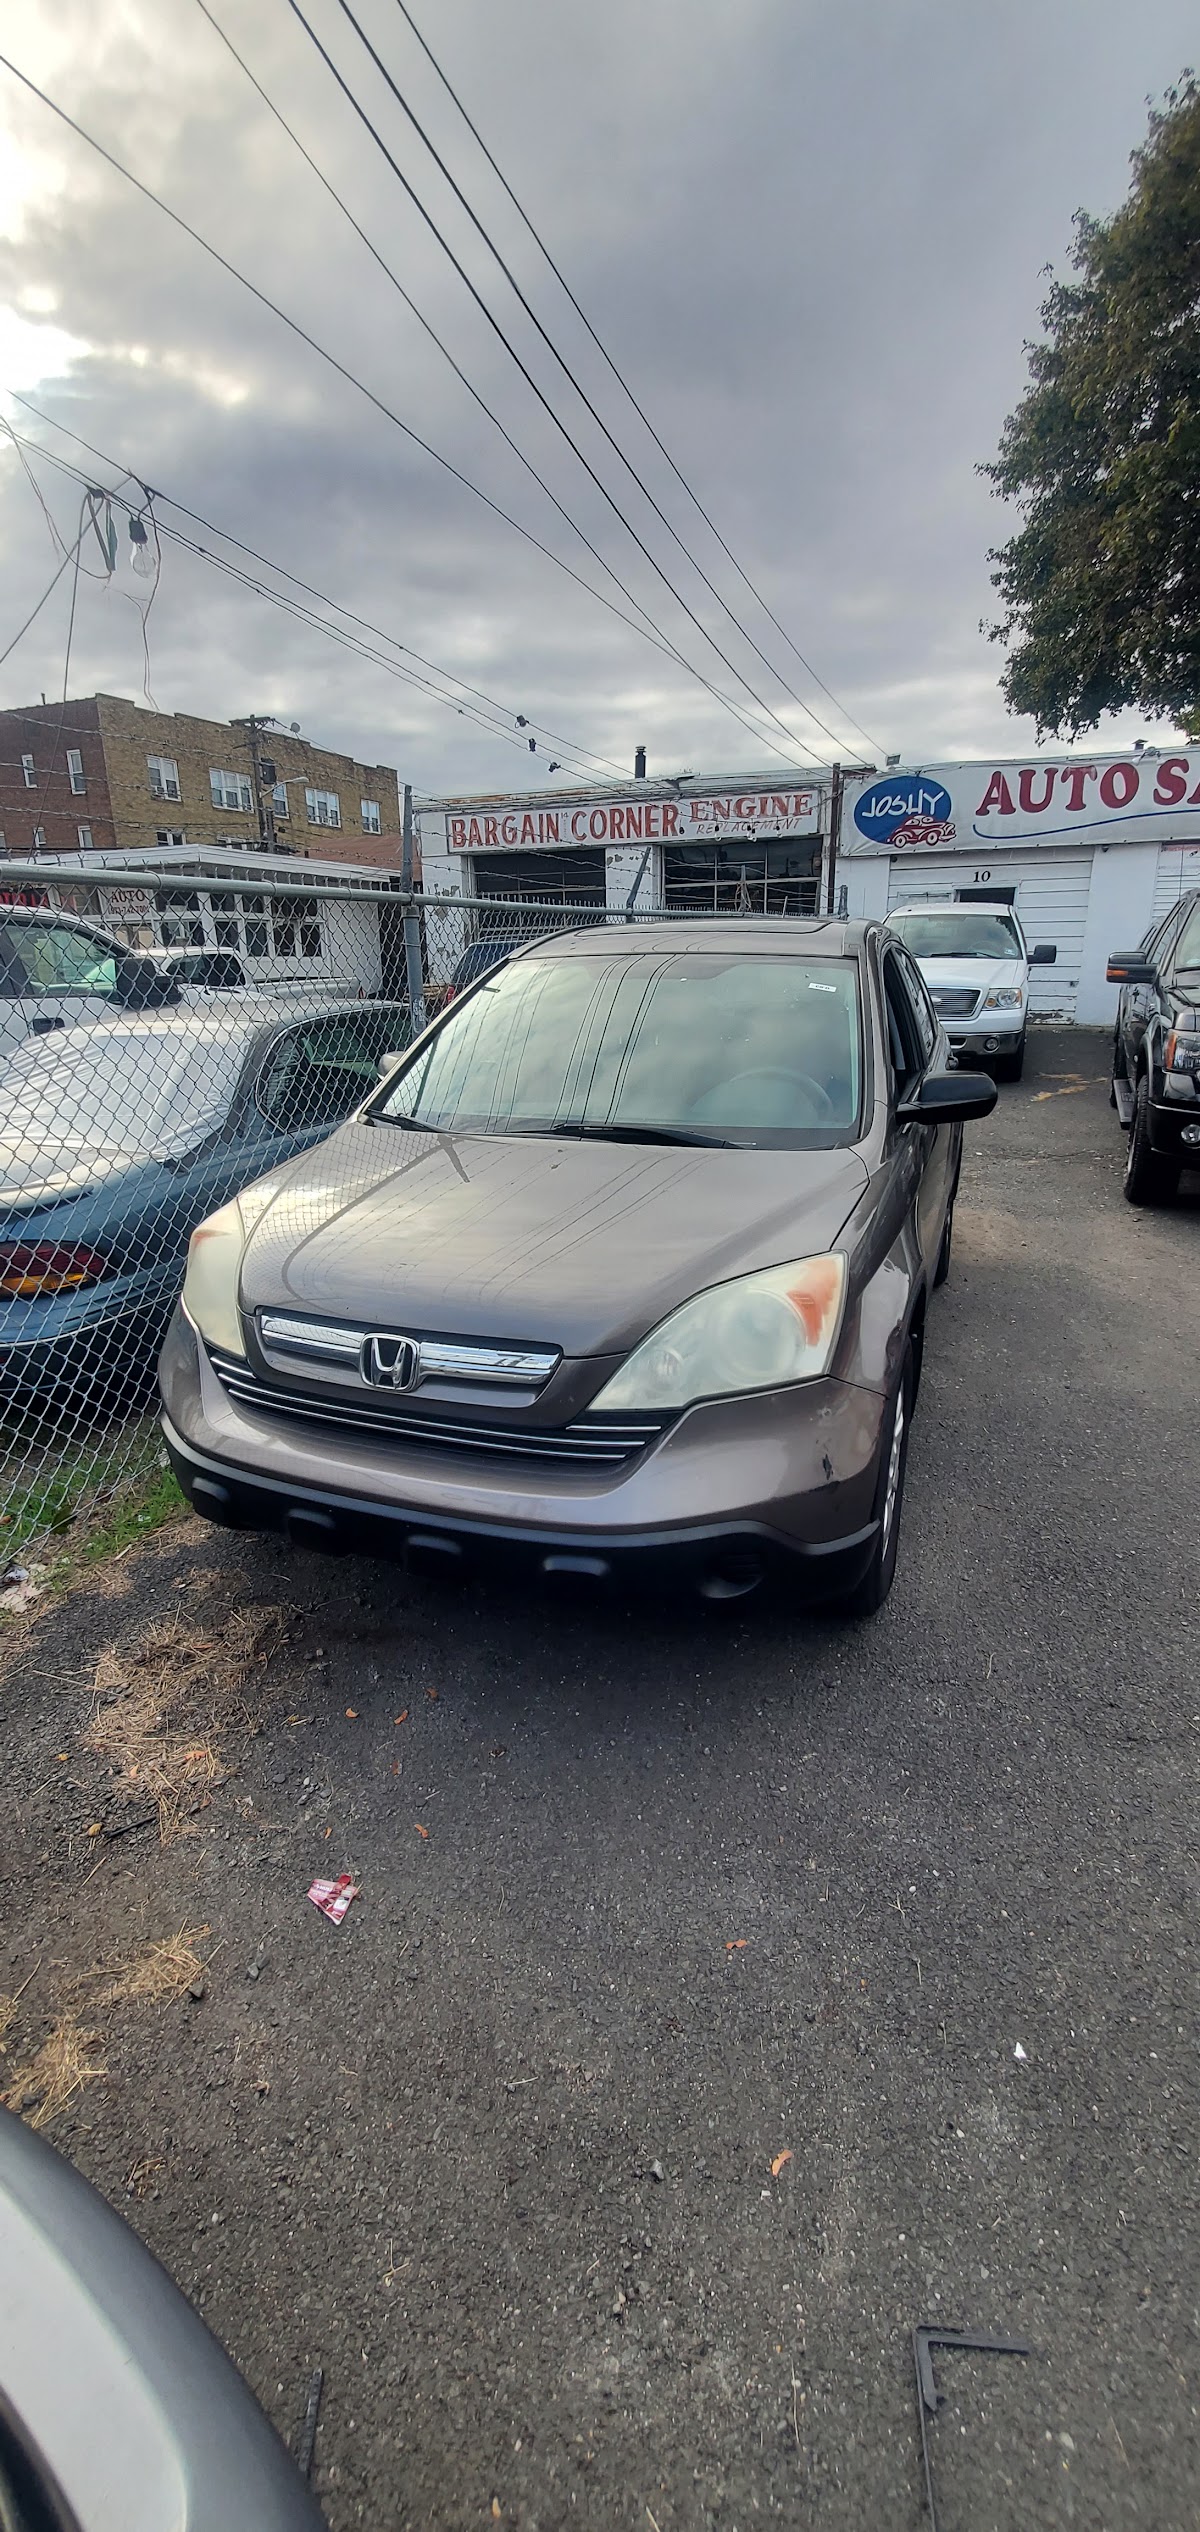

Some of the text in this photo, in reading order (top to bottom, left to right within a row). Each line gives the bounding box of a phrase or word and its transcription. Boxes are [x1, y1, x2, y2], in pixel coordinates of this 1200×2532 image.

[862, 789, 944, 817] JOSHY
[975, 762, 1140, 816] AUTO
[451, 812, 560, 848] BARGAIN
[571, 804, 679, 841] CORNER
[690, 794, 812, 822] ENGINE
[973, 870, 991, 883] 10
[111, 890, 146, 903] AUTO
